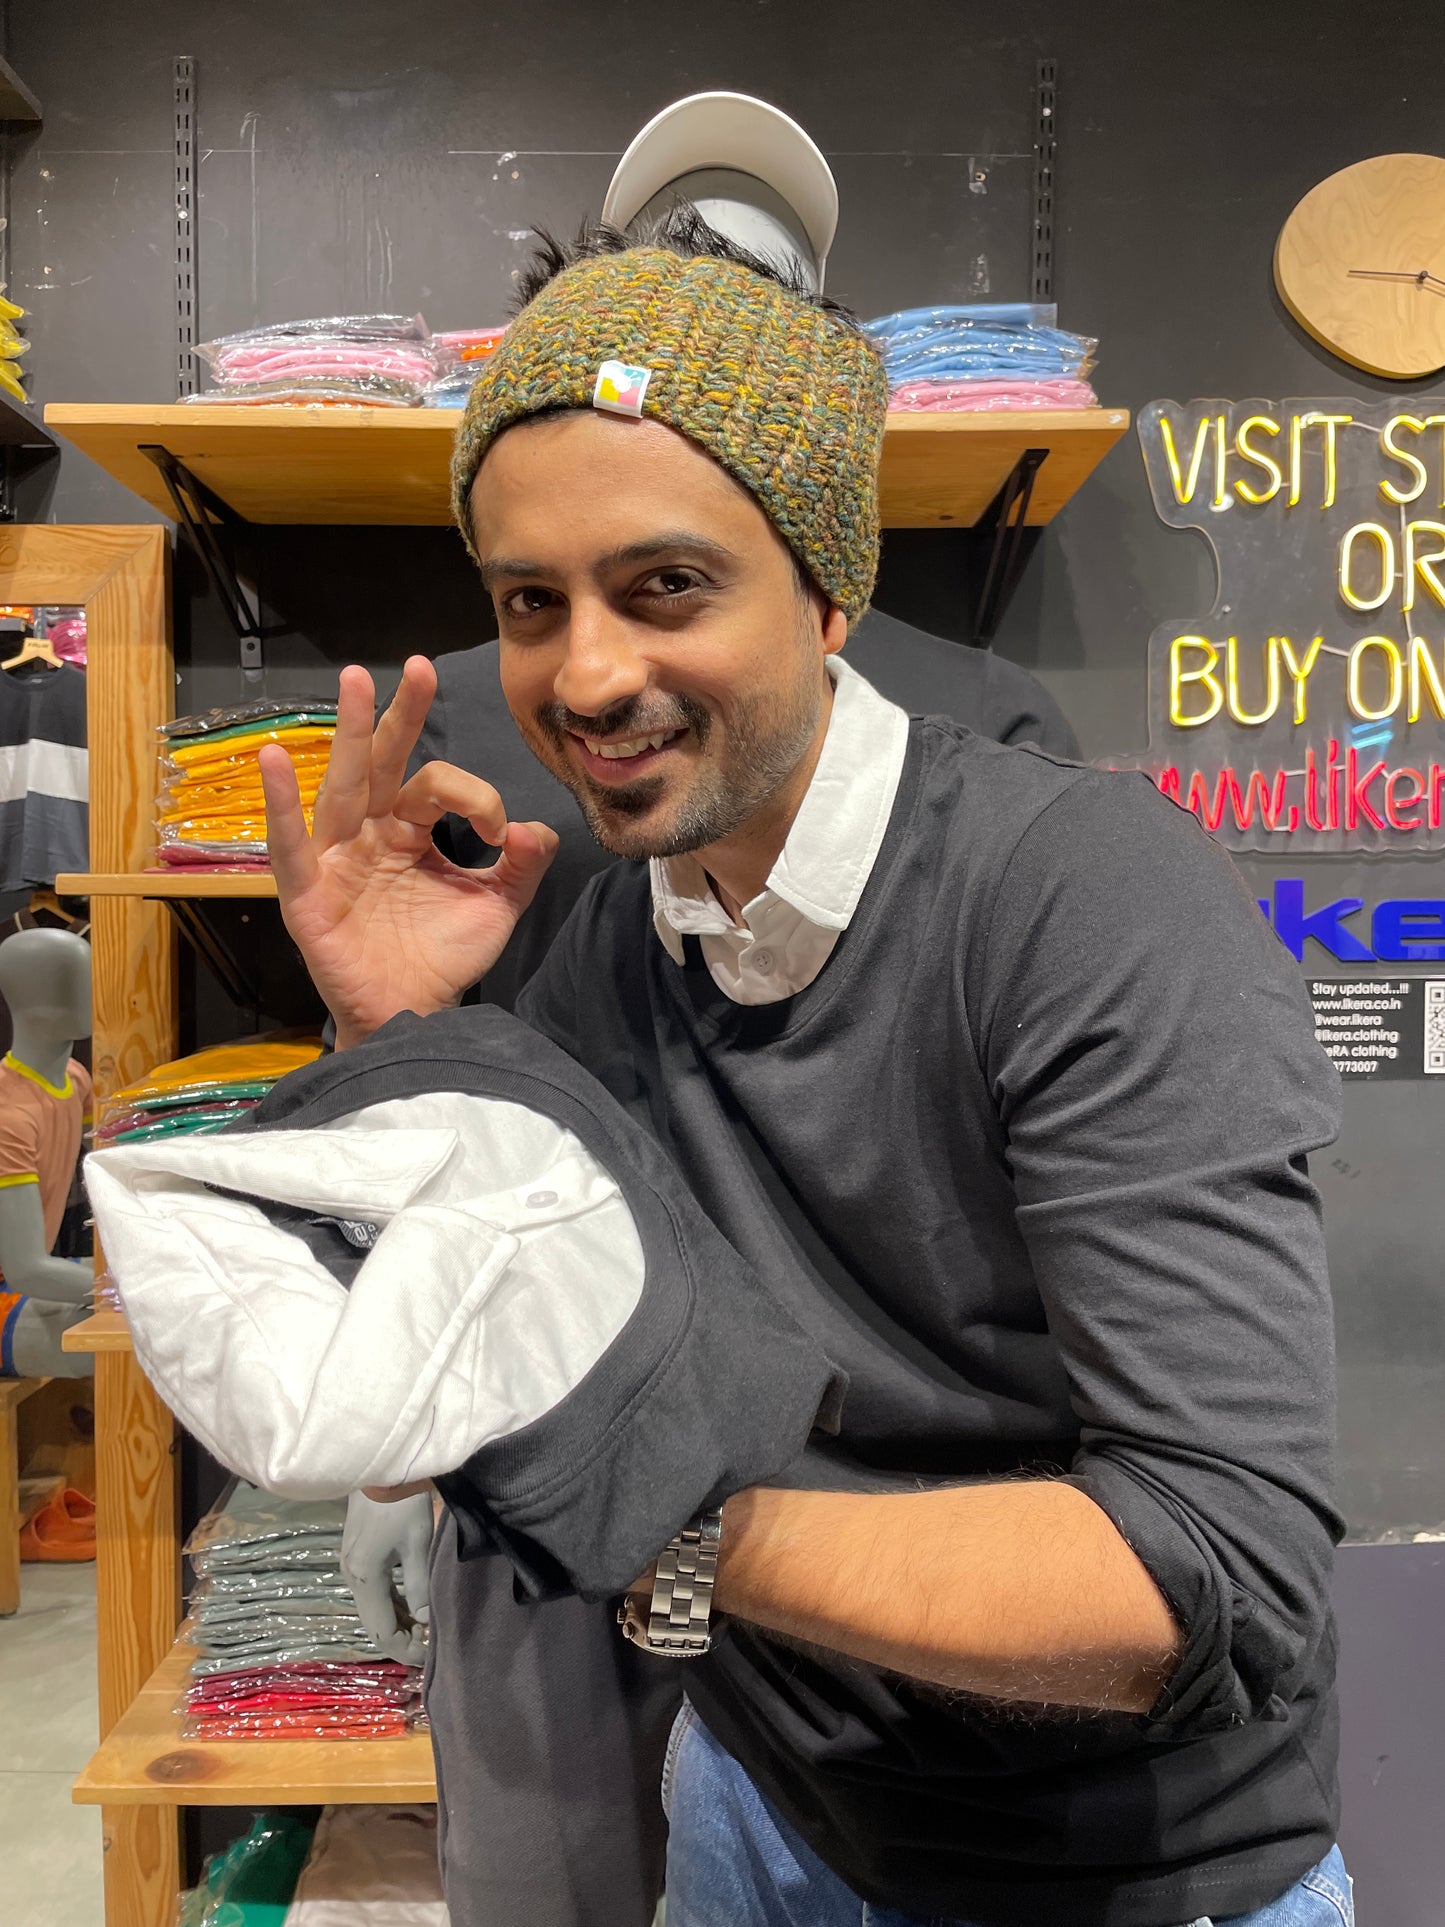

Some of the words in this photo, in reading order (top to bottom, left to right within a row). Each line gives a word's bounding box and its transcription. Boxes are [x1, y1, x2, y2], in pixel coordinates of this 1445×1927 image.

[1160, 415, 1353, 508] VISIT
[1338, 520, 1445, 612] OR
[1170, 635, 1324, 727] BUY
[1157, 739, 1445, 832] ww.liker
[1257, 879, 1445, 962] ke
[1312, 982, 1337, 997] Stay
[1312, 997, 1402, 1010] www.likera.co.in
[1314, 1029, 1400, 1043] @likera.clothing
[1324, 1045, 1349, 1057] eRA
[1351, 1044, 1398, 1059] clothing
